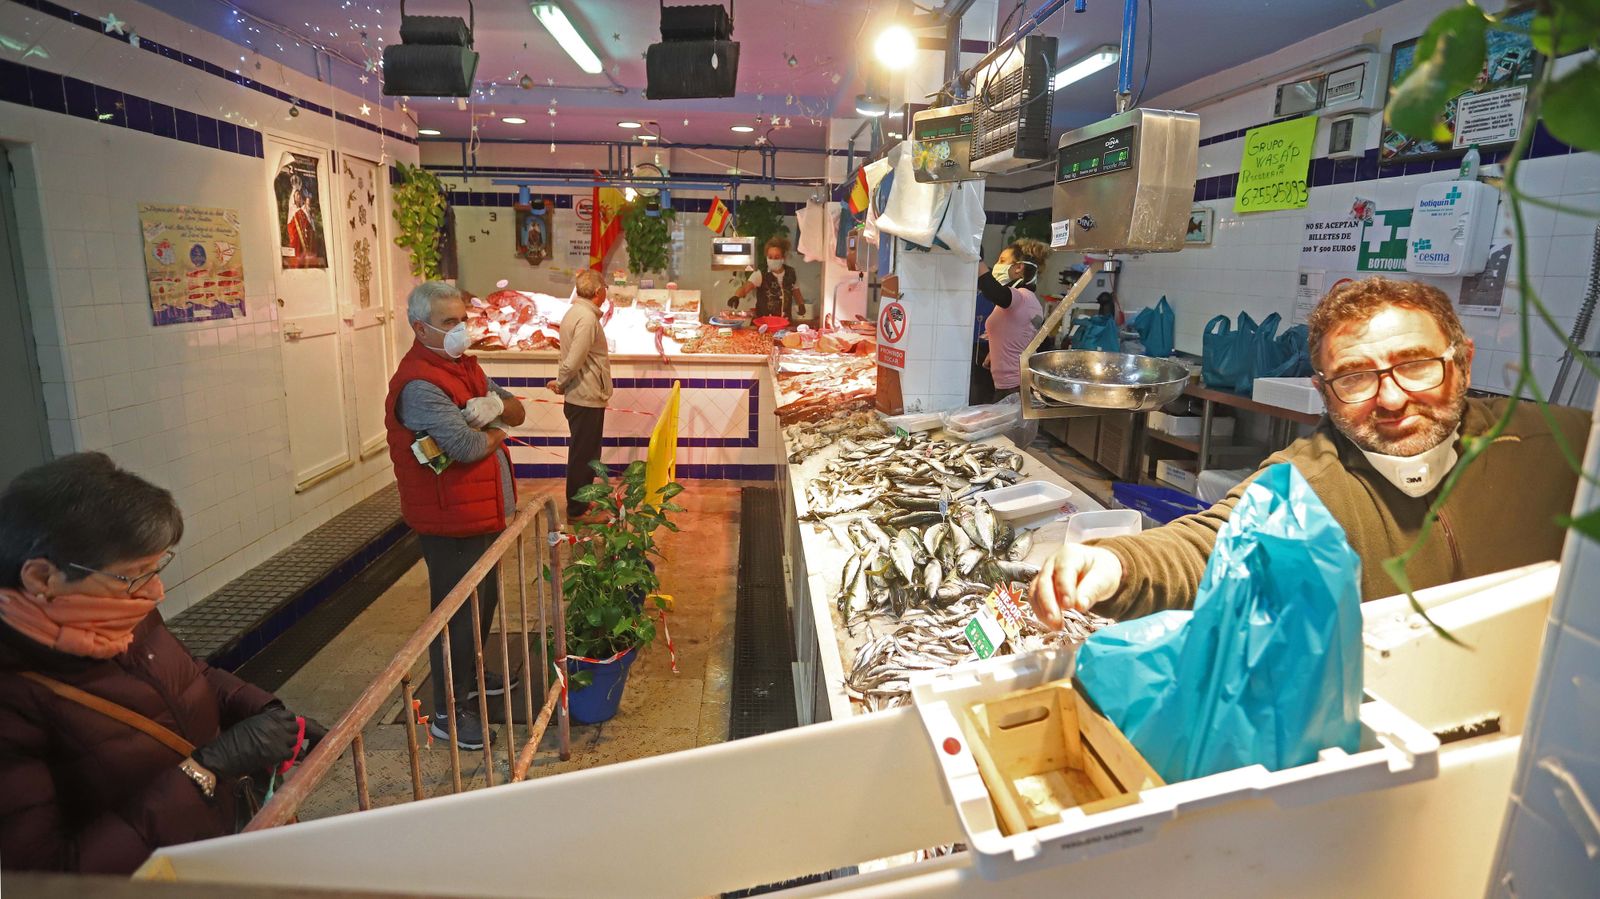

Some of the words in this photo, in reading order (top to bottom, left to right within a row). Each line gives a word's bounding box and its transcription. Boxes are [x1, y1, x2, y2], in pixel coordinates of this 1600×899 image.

[1247, 132, 1283, 156] GRUPO
[489, 212, 497, 222] 3
[1305, 222, 1315, 230] NO
[1324, 220, 1359, 229] ACEPTAN
[1308, 232, 1340, 241] BILLETES
[1341, 232, 1352, 240] DE
[1331, 244, 1356, 252] EUROS
[1419, 252, 1450, 262] cesma
[998, 589, 1022, 620] MEJOR
[994, 596, 1015, 625] PRECIO
